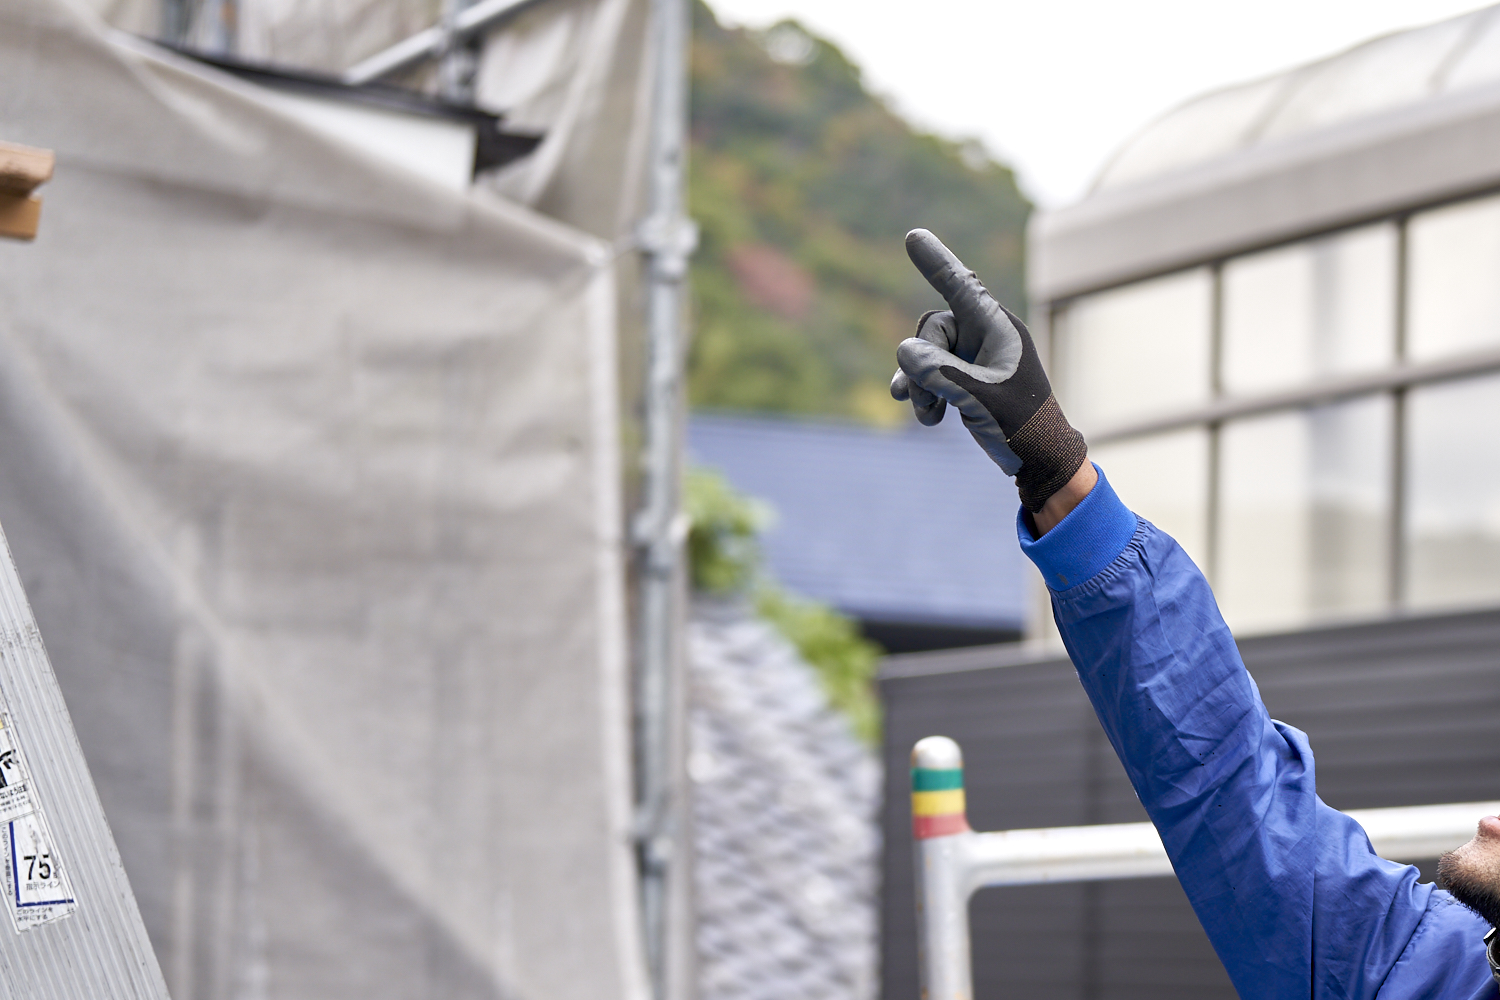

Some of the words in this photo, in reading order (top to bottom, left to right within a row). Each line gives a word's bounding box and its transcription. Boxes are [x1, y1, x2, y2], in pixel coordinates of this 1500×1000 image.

[26, 881, 61, 892] 指示ライン
